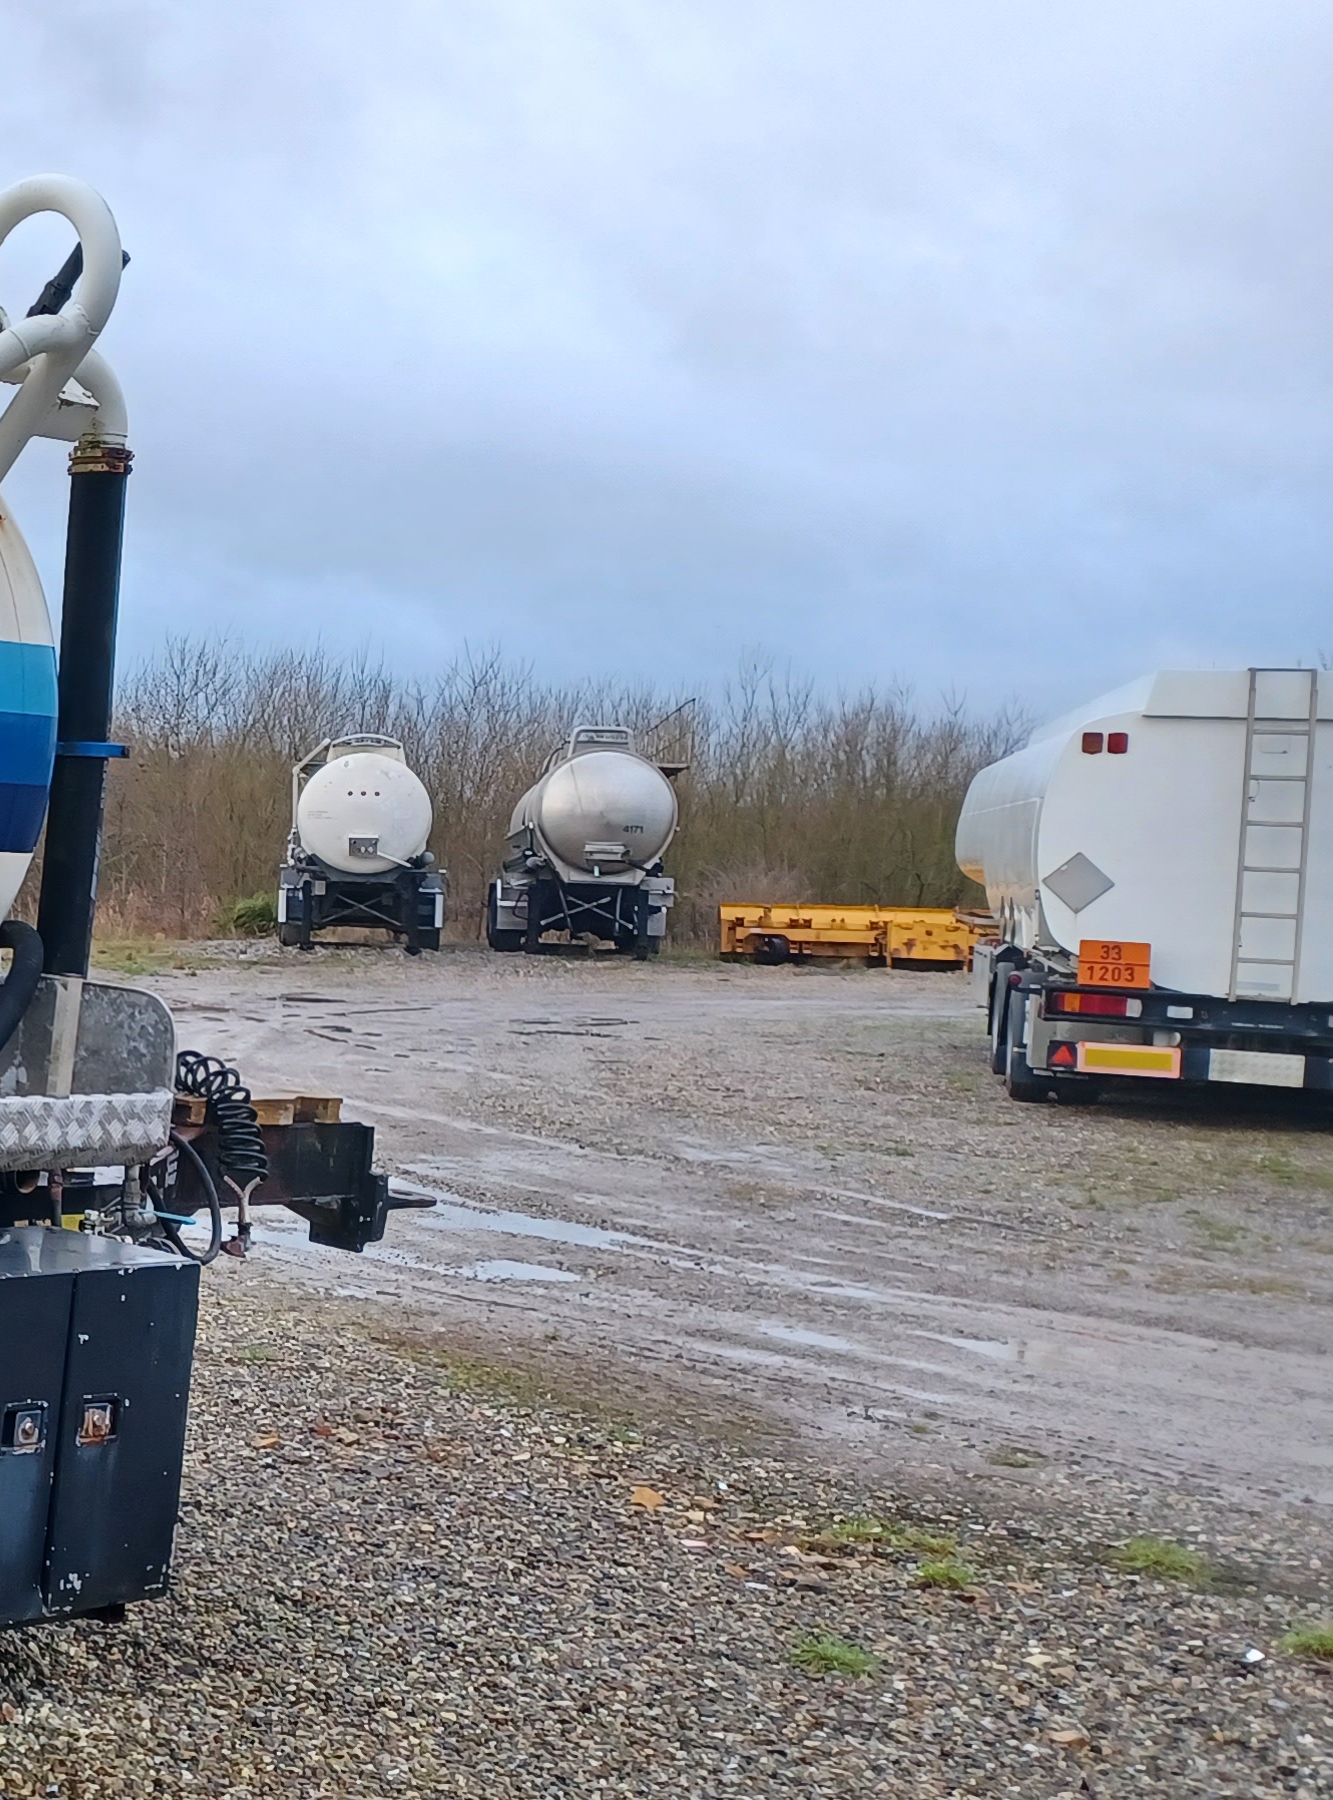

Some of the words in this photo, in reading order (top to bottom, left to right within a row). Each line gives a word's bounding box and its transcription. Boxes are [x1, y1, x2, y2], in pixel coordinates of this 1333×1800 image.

[623, 825, 644, 834] 4171
[1100, 944, 1122, 961] 33
[1087, 965, 1135, 982] 1203
